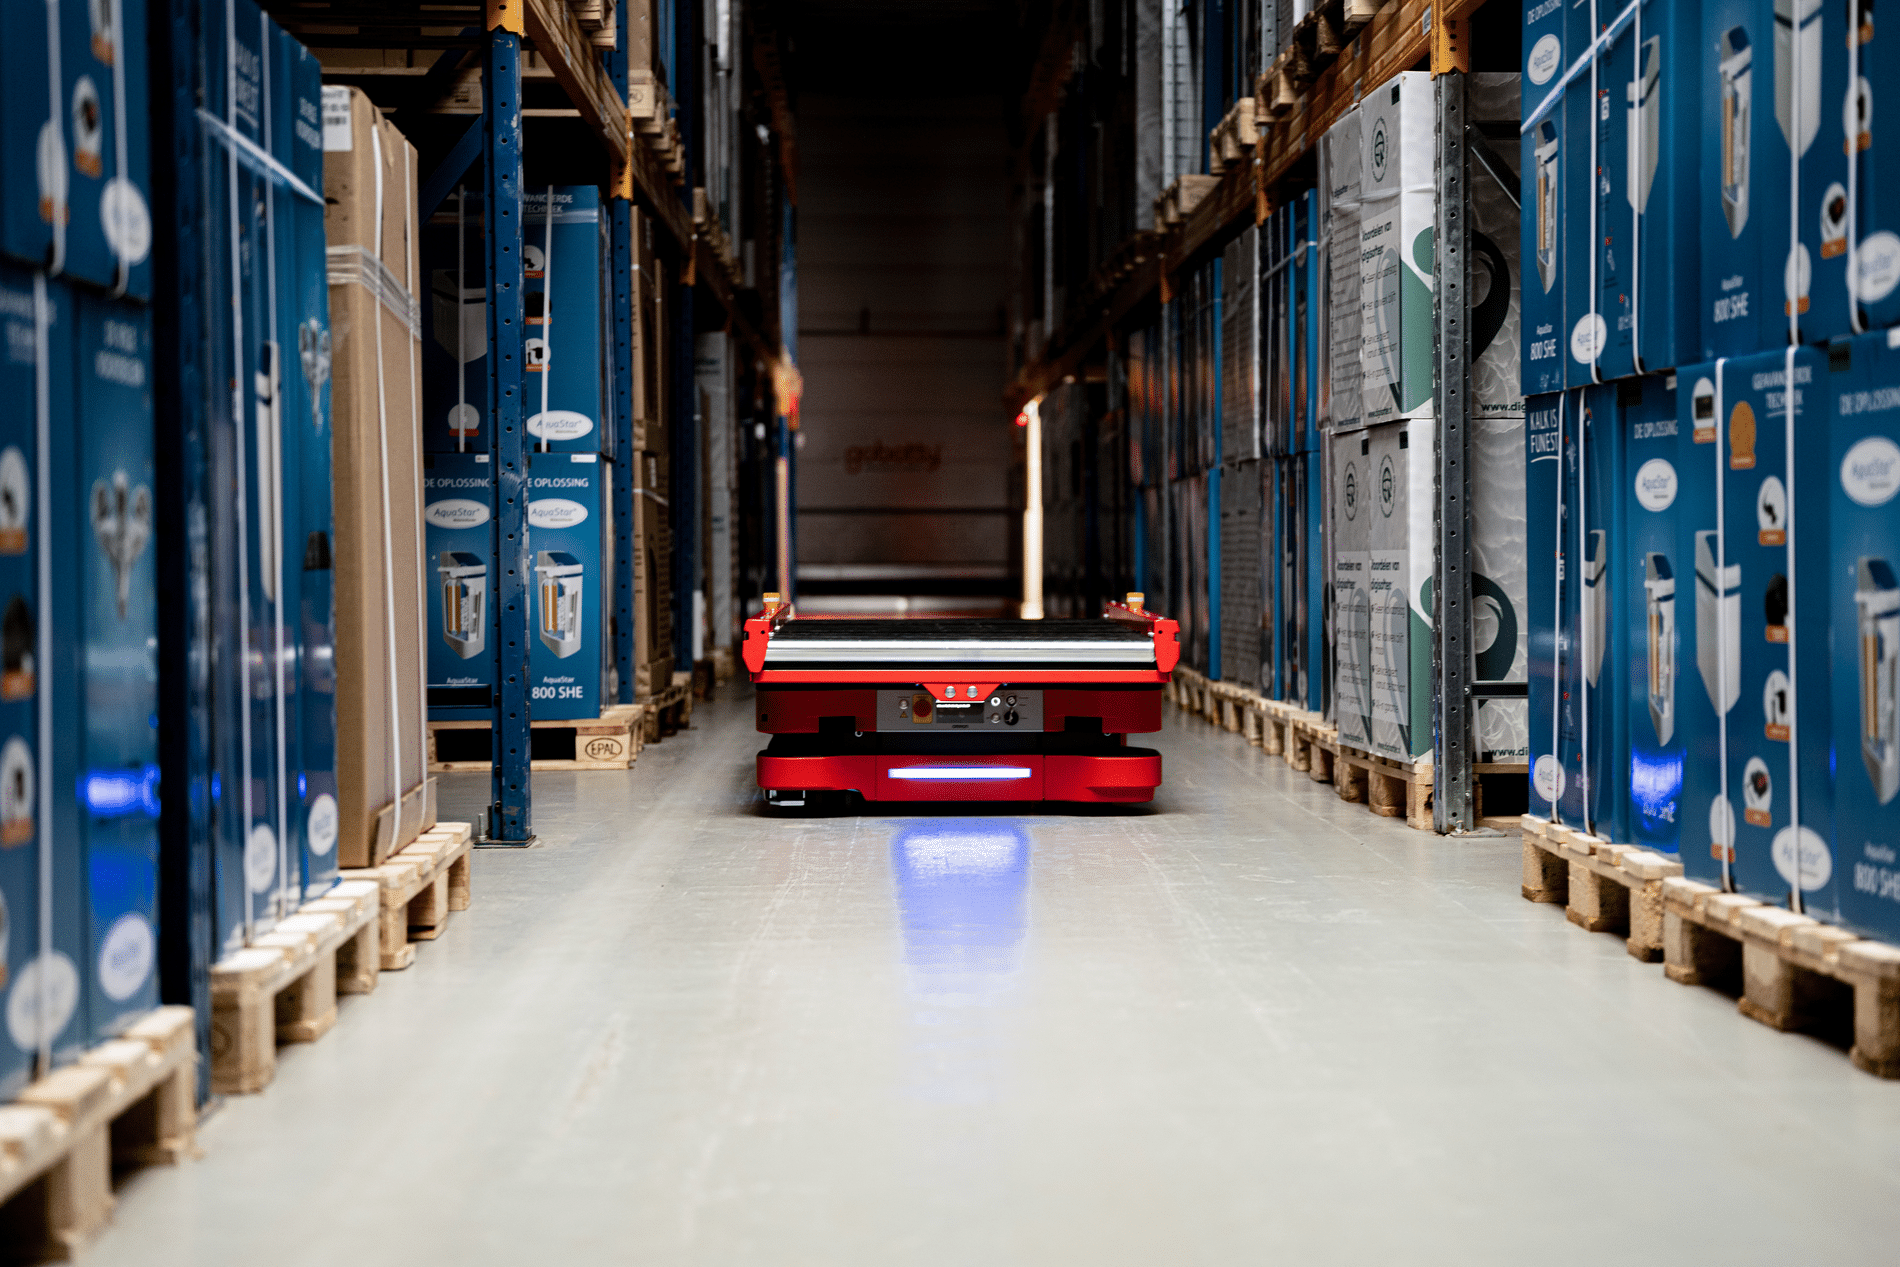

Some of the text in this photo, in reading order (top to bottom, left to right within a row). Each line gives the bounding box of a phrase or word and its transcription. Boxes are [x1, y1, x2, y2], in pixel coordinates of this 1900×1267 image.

[1530, 342, 1543, 360] 800
[1543, 338, 1557, 358] SHE
[536, 419, 579, 429] AuaStar
[1530, 408, 1558, 431] KALK IS
[1530, 431, 1559, 453] FUNEST
[534, 477, 589, 488] OPLOSSING
[434, 507, 477, 518] AquaStar
[531, 507, 574, 518] AquaStar
[543, 676, 575, 684] AquaStar
[532, 686, 583, 699] 800 SHE
[591, 742, 617, 756] EPAL
